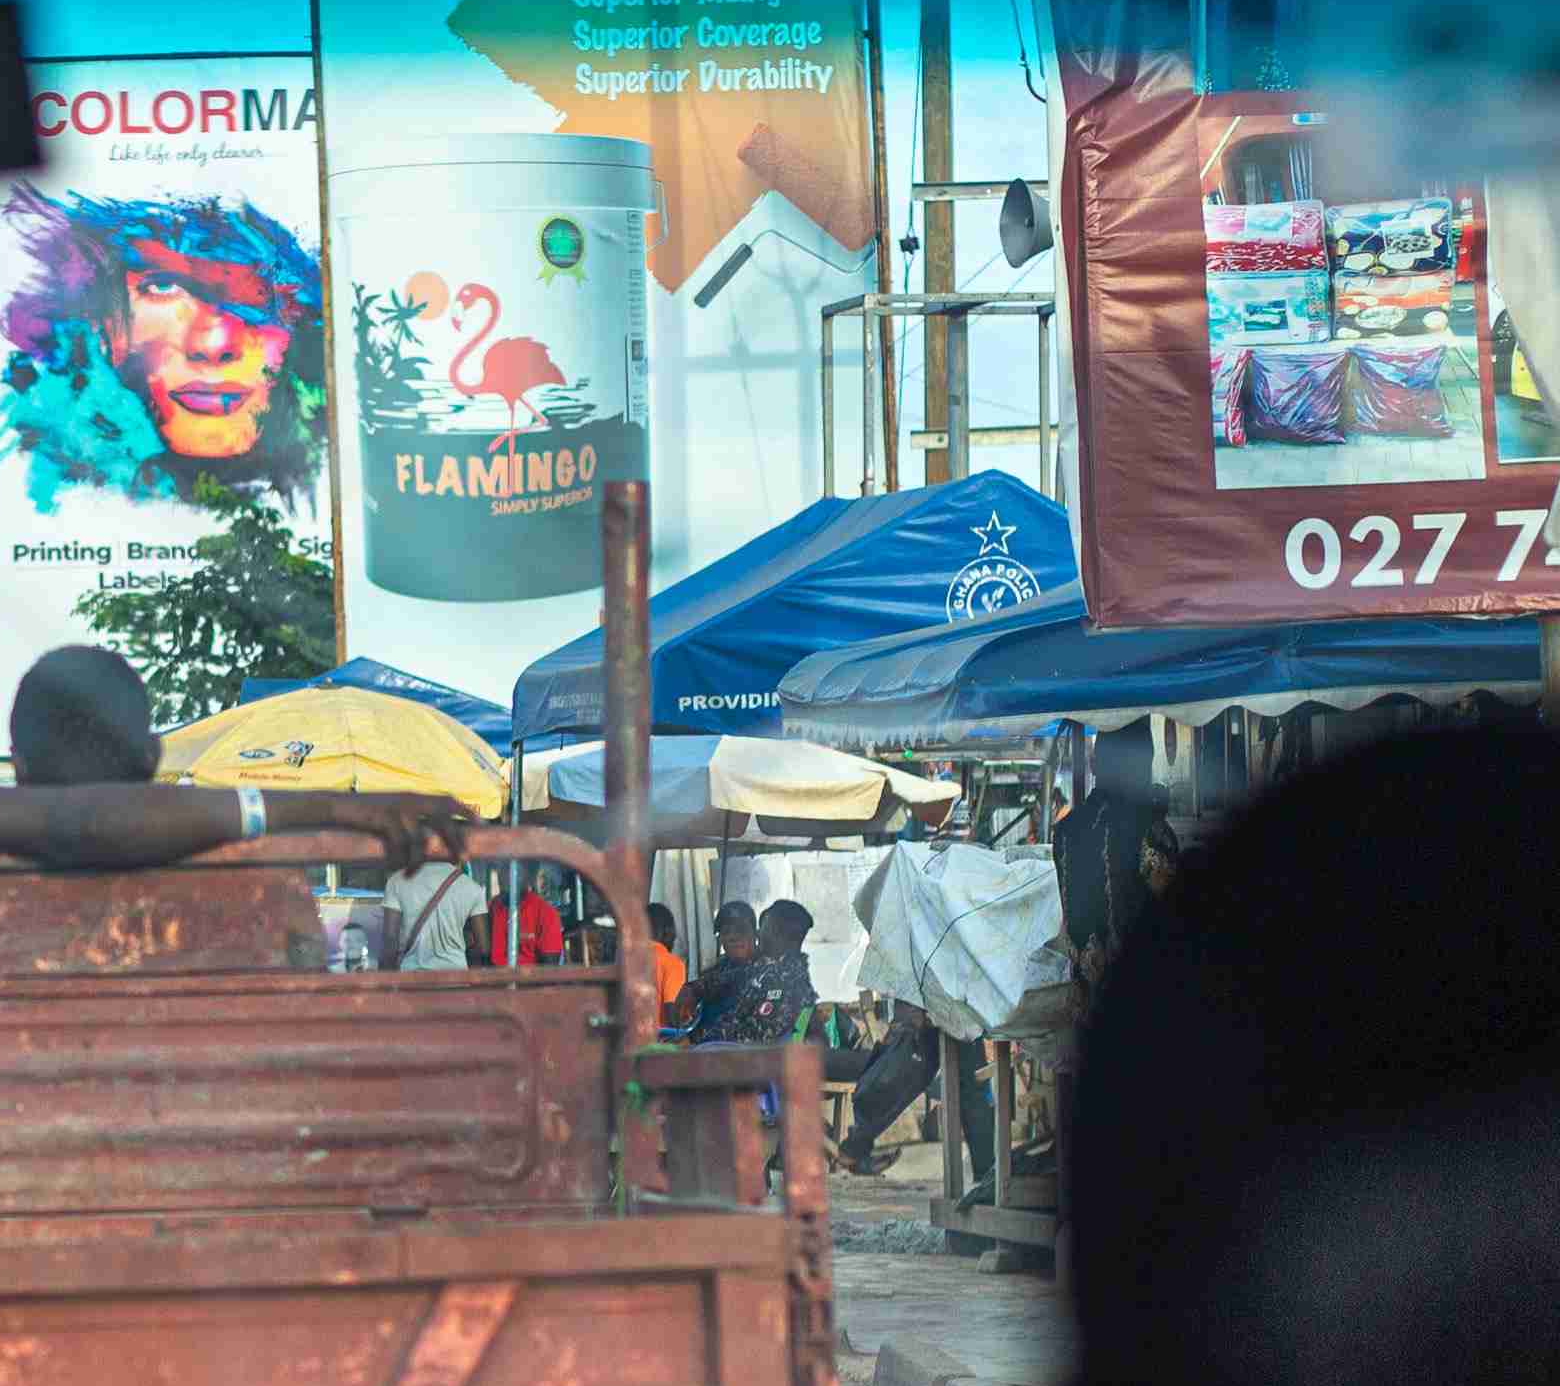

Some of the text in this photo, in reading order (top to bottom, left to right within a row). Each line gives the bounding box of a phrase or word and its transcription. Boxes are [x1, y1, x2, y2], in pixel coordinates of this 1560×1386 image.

[573, 16, 823, 57] Superior Coverage
[575, 57, 834, 101] Superior Durability
[395, 444, 598, 499] FLAMINGO
[13, 540, 113, 565] Printing
[1284, 513, 1468, 591] 027
[953, 564, 993, 610] GHANA
